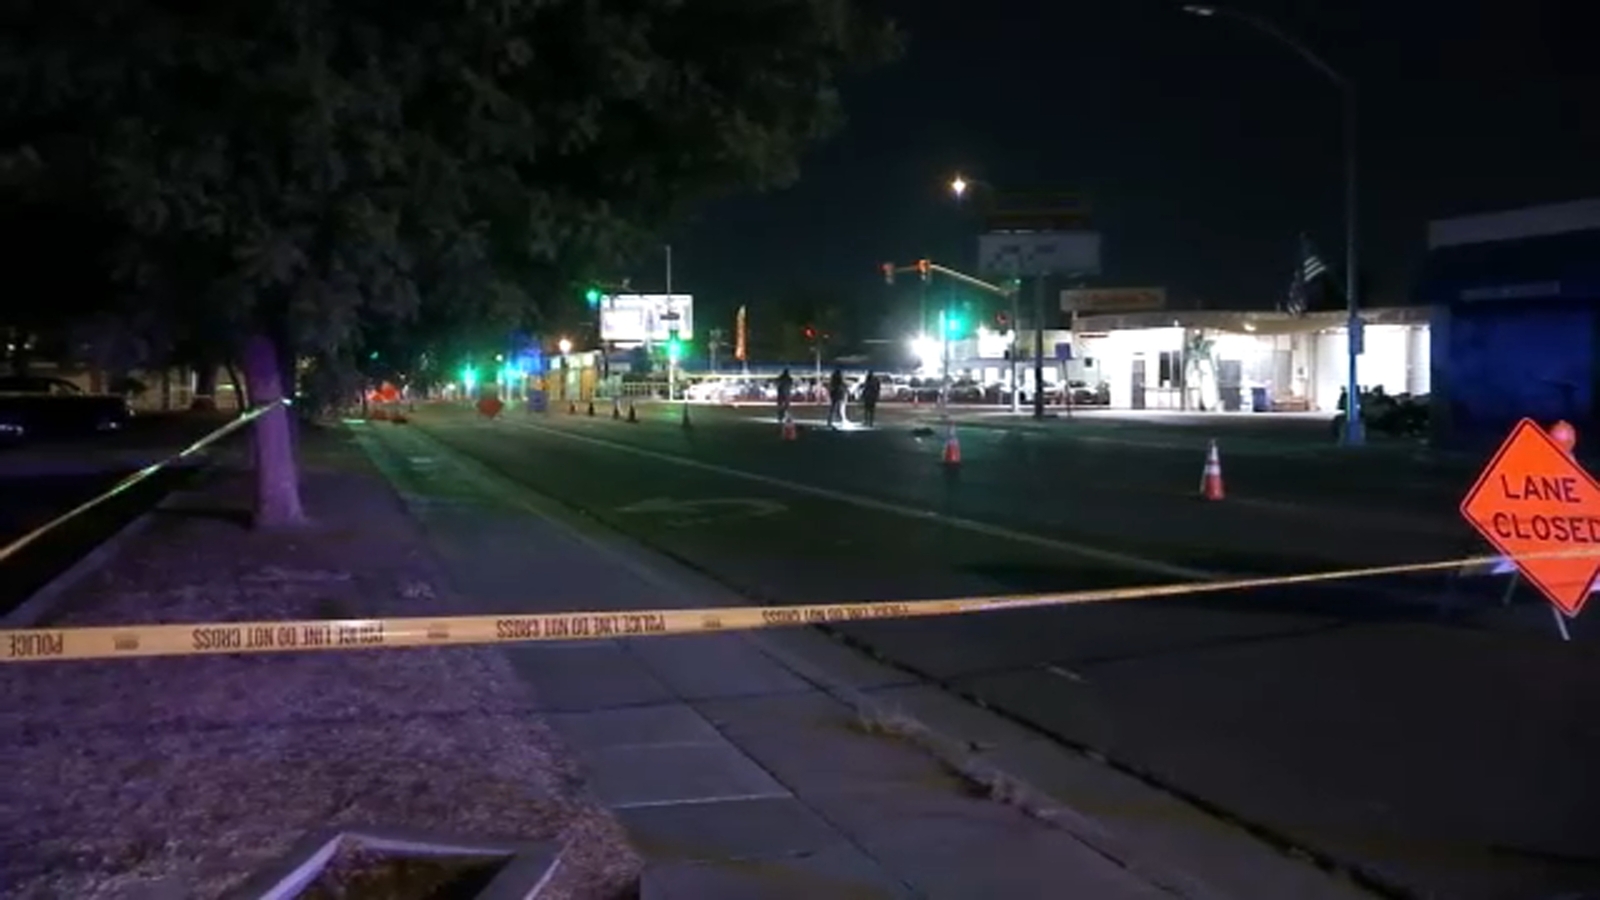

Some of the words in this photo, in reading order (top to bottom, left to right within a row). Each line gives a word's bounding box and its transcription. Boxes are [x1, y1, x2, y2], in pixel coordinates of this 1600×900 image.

[1501, 474, 1580, 503] LANE
[1493, 512, 1600, 542] CLOSED
[301, 624, 332, 646] LINE
[338, 621, 384, 645] POLICE
[496, 619, 539, 639] CROSS
[544, 619, 568, 638] NOT
[572, 617, 588, 636] DO
[594, 616, 620, 635] LINE
[623, 615, 666, 634] POLICE
[7, 632, 63, 657] POLICE
[192, 626, 241, 649] CROSS
[246, 626, 273, 648] NOT
[277, 626, 296, 647] DO
